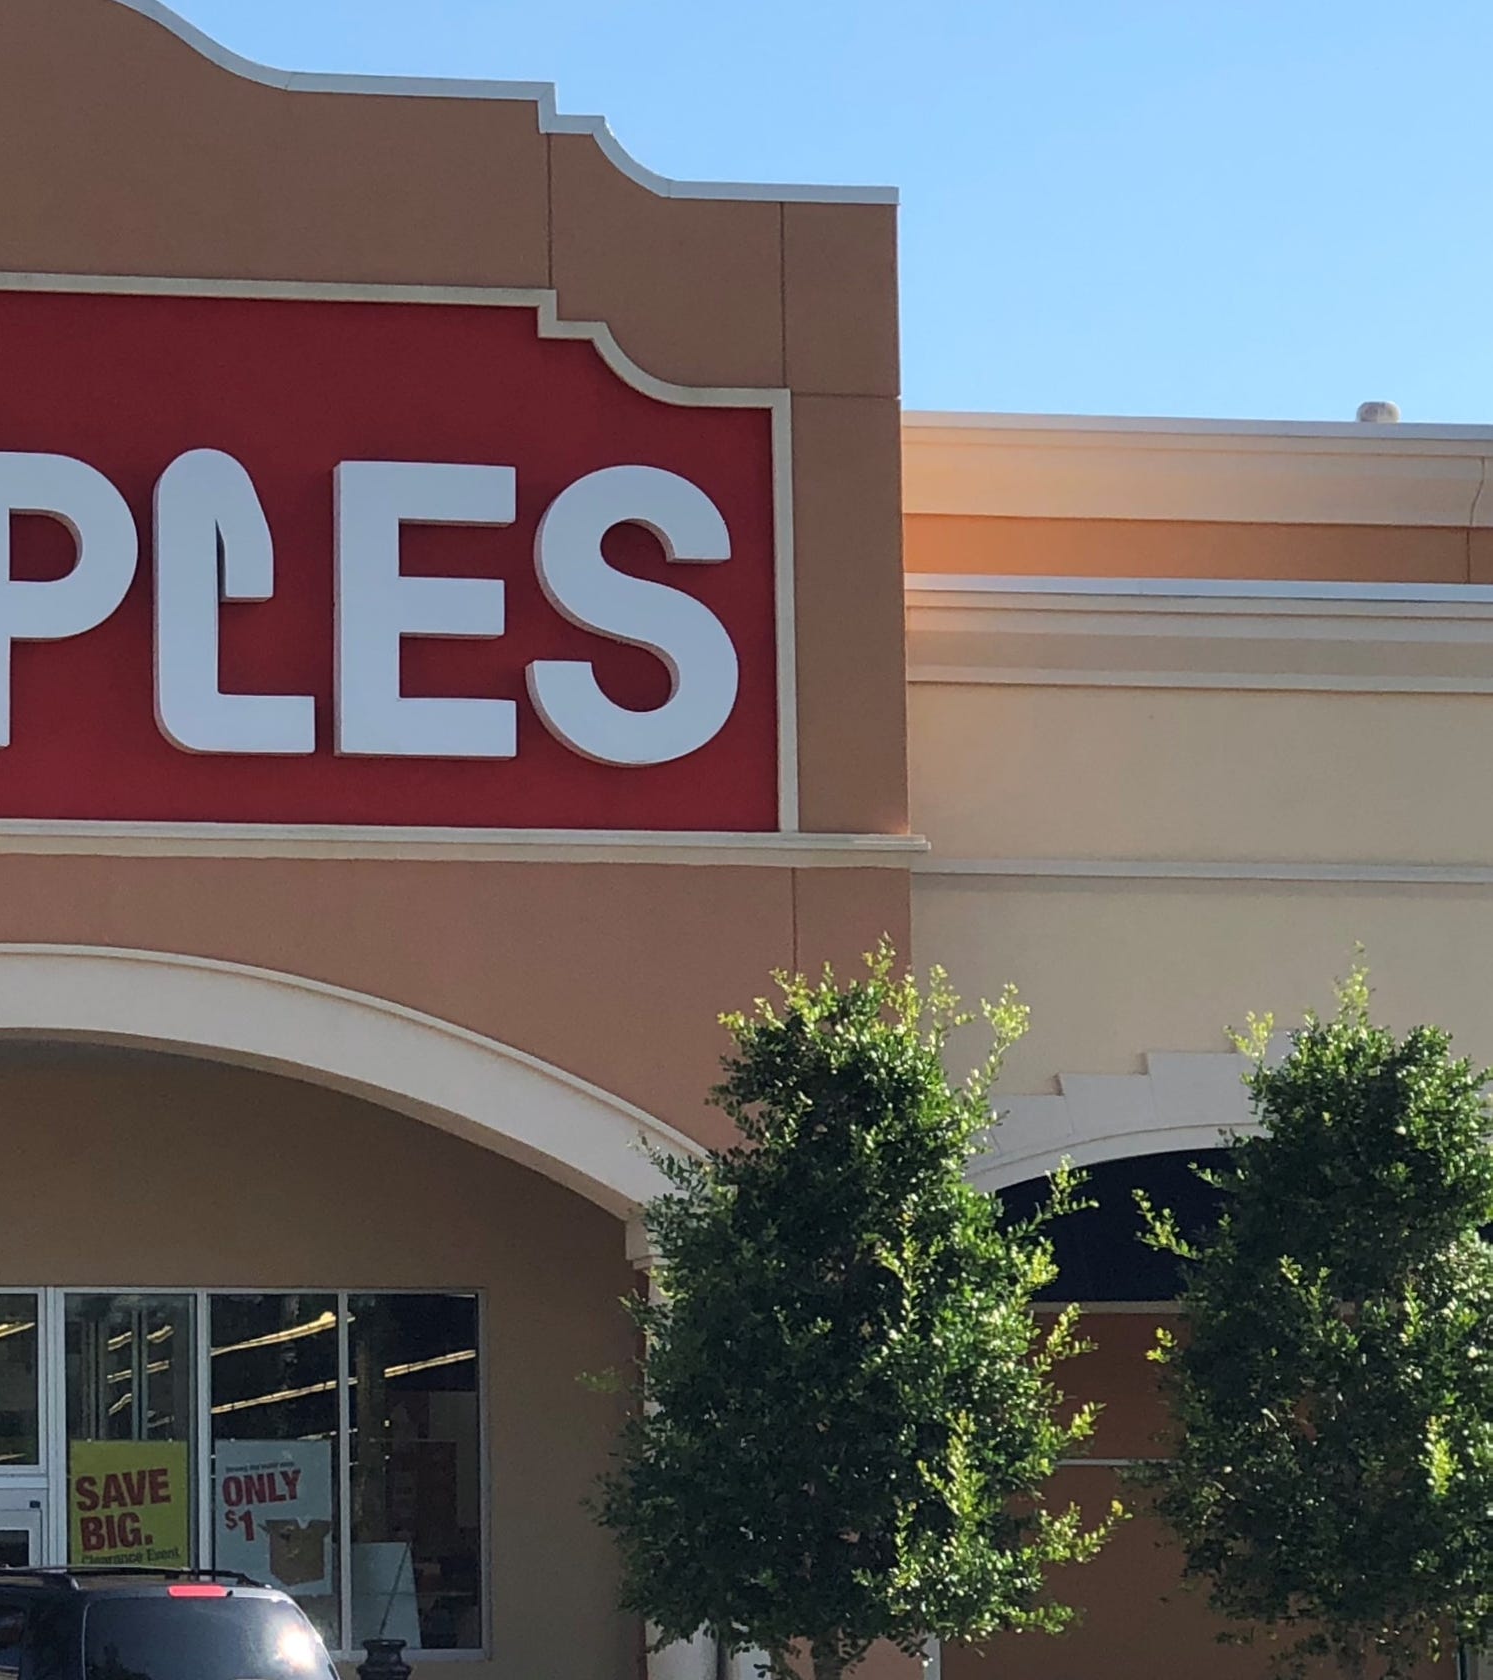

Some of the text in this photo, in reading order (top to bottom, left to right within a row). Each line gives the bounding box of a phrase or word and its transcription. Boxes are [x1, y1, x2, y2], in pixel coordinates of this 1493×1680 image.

[75, 1468, 172, 1512] SAVE
[222, 1468, 301, 1508] ONLY
[80, 1512, 153, 1552] BIG.
[225, 1509, 255, 1542] $1
[146, 1547, 179, 1561] Event
